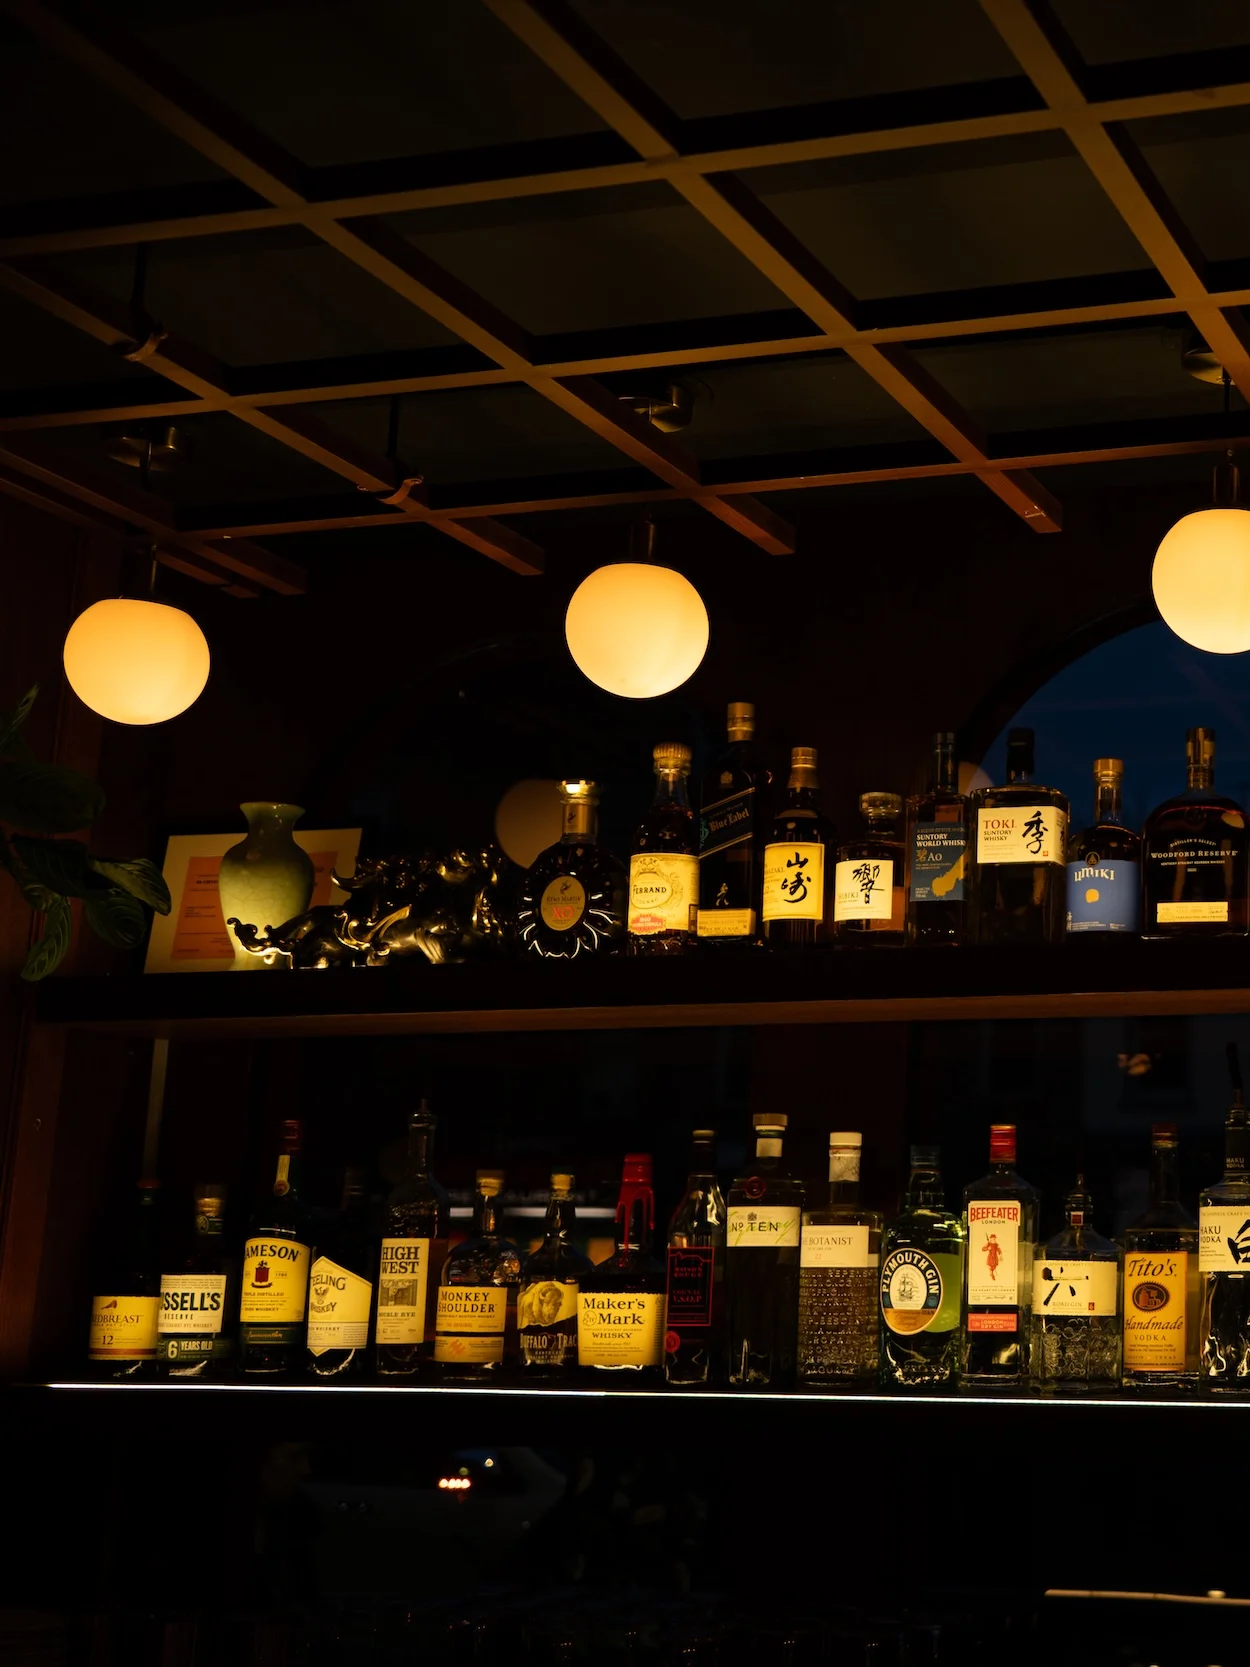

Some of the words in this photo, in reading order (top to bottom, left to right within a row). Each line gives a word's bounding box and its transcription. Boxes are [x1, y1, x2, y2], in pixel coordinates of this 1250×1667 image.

[709, 817, 728, 832] Blue
[728, 808, 750, 826] Label
[983, 820, 1015, 829] TOKI
[1151, 850, 1196, 858] WOODFORD
[553, 906, 573, 919] XO
[970, 1207, 1018, 1223] BEEFEATER
[749, 1222, 778, 1231] TEN
[809, 1237, 853, 1245] BOTANIST
[245, 1245, 299, 1262] AMESON
[382, 1247, 420, 1260] HIGH
[382, 1261, 419, 1274] WEST
[882, 1252, 929, 1293] PLYMOUTH
[926, 1268, 939, 1294] GIN
[1042, 1266, 1089, 1306] 六
[160, 1292, 220, 1311] SSELL'S
[441, 1291, 490, 1301] MONKEY
[310, 1302, 337, 1313] HISKEY
[438, 1303, 495, 1312] SHOULDER
[583, 1298, 645, 1310] Maker's
[92, 1315, 140, 1323] EDBREAST
[598, 1313, 644, 1324] Mark
[1125, 1316, 1183, 1330] Handmade
[102, 1335, 113, 1345] 12
[520, 1333, 547, 1349] BUFFALO
[556, 1333, 577, 1347] TRAC
[168, 1341, 177, 1358] 6
[180, 1341, 200, 1350] YEARS
[201, 1341, 212, 1350] OLD
